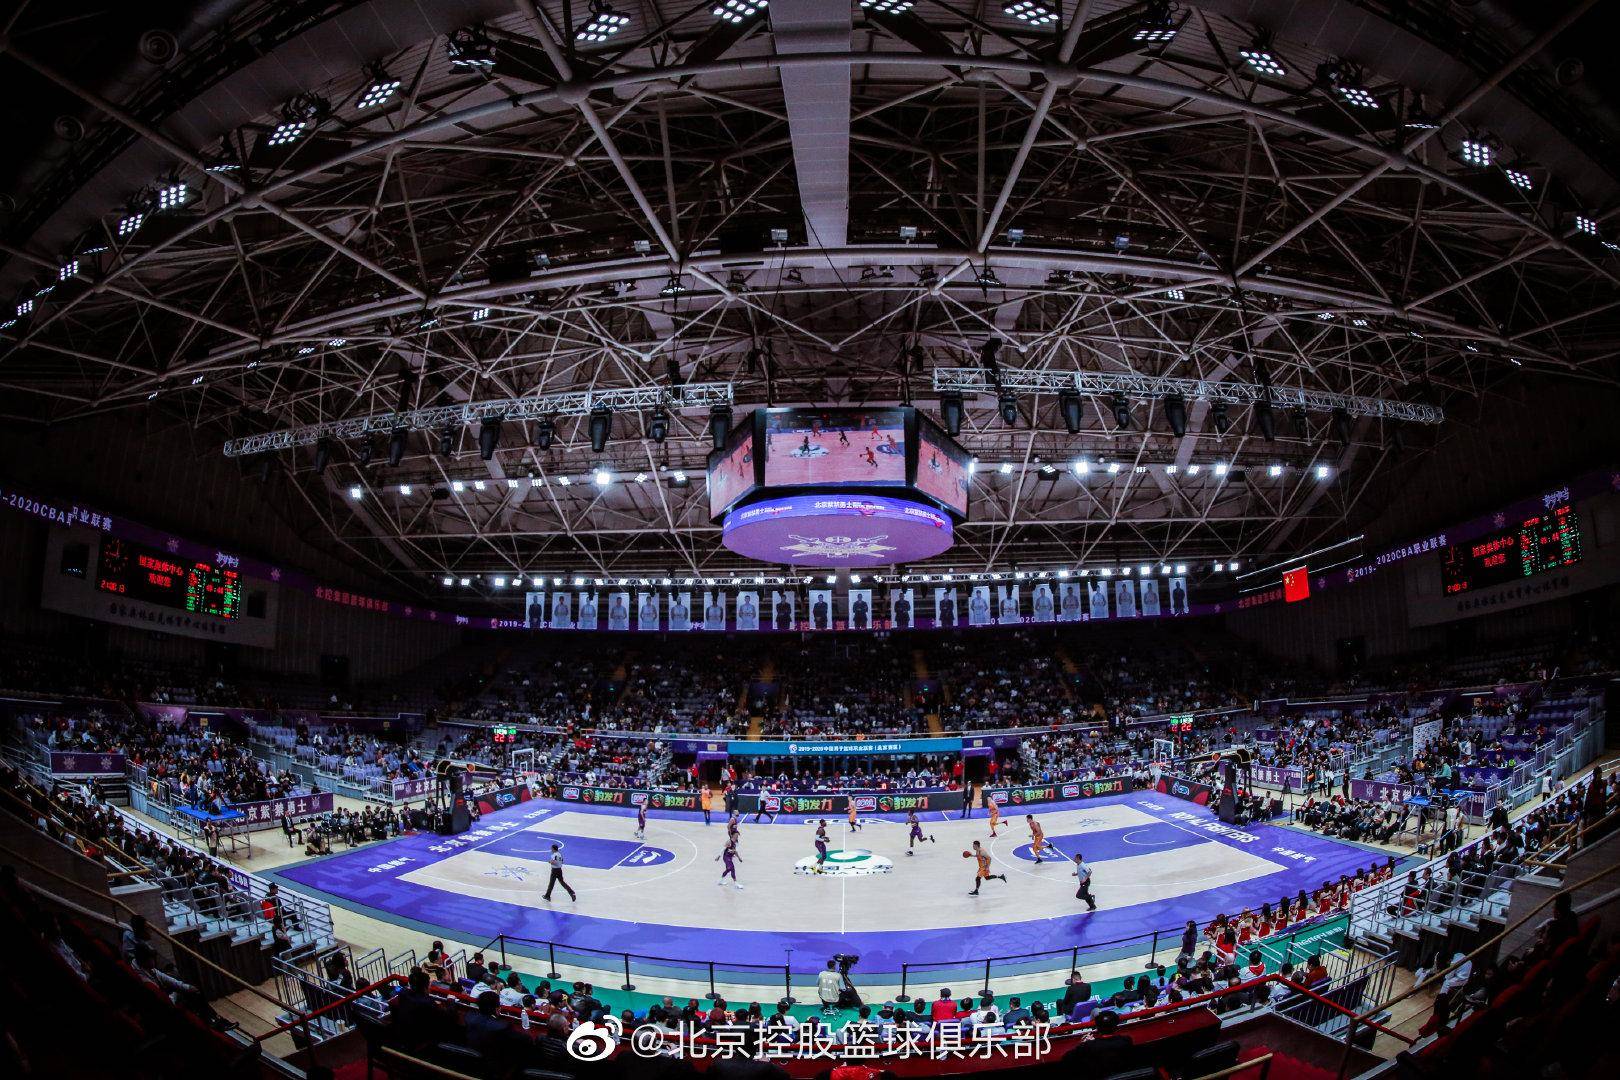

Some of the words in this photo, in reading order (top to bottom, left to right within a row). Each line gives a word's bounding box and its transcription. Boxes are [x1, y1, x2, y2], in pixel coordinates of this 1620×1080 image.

[1024, 786, 1055, 802] 豹发力
[1094, 780, 1124, 795] 豹发力
[594, 789, 625, 804] 豹发力
[663, 793, 697, 809] 豹发力
[893, 796, 929, 810] 豹发力
[798, 797, 833, 812] 豹发力
